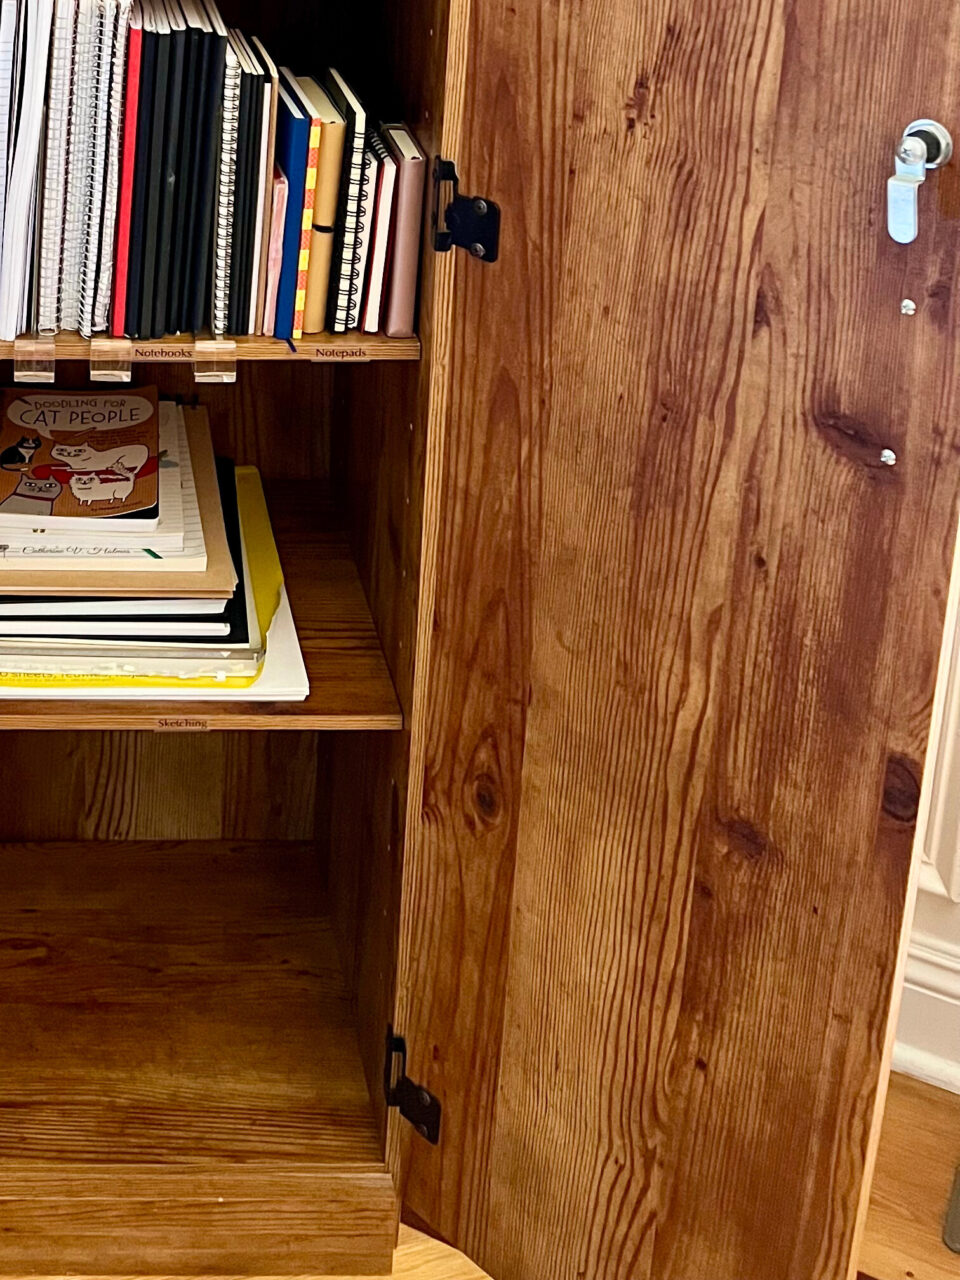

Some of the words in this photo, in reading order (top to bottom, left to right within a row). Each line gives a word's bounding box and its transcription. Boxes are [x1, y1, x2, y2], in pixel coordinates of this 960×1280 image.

[134, 347, 193, 358] Notebooks
[315, 348, 367, 359] Notepads
[34, 399, 98, 410] DOODLING
[103, 399, 126, 408] FOR
[20, 409, 62, 426] CAT
[69, 408, 141, 425] PEOPLE
[157, 719, 208, 729] Sketching
